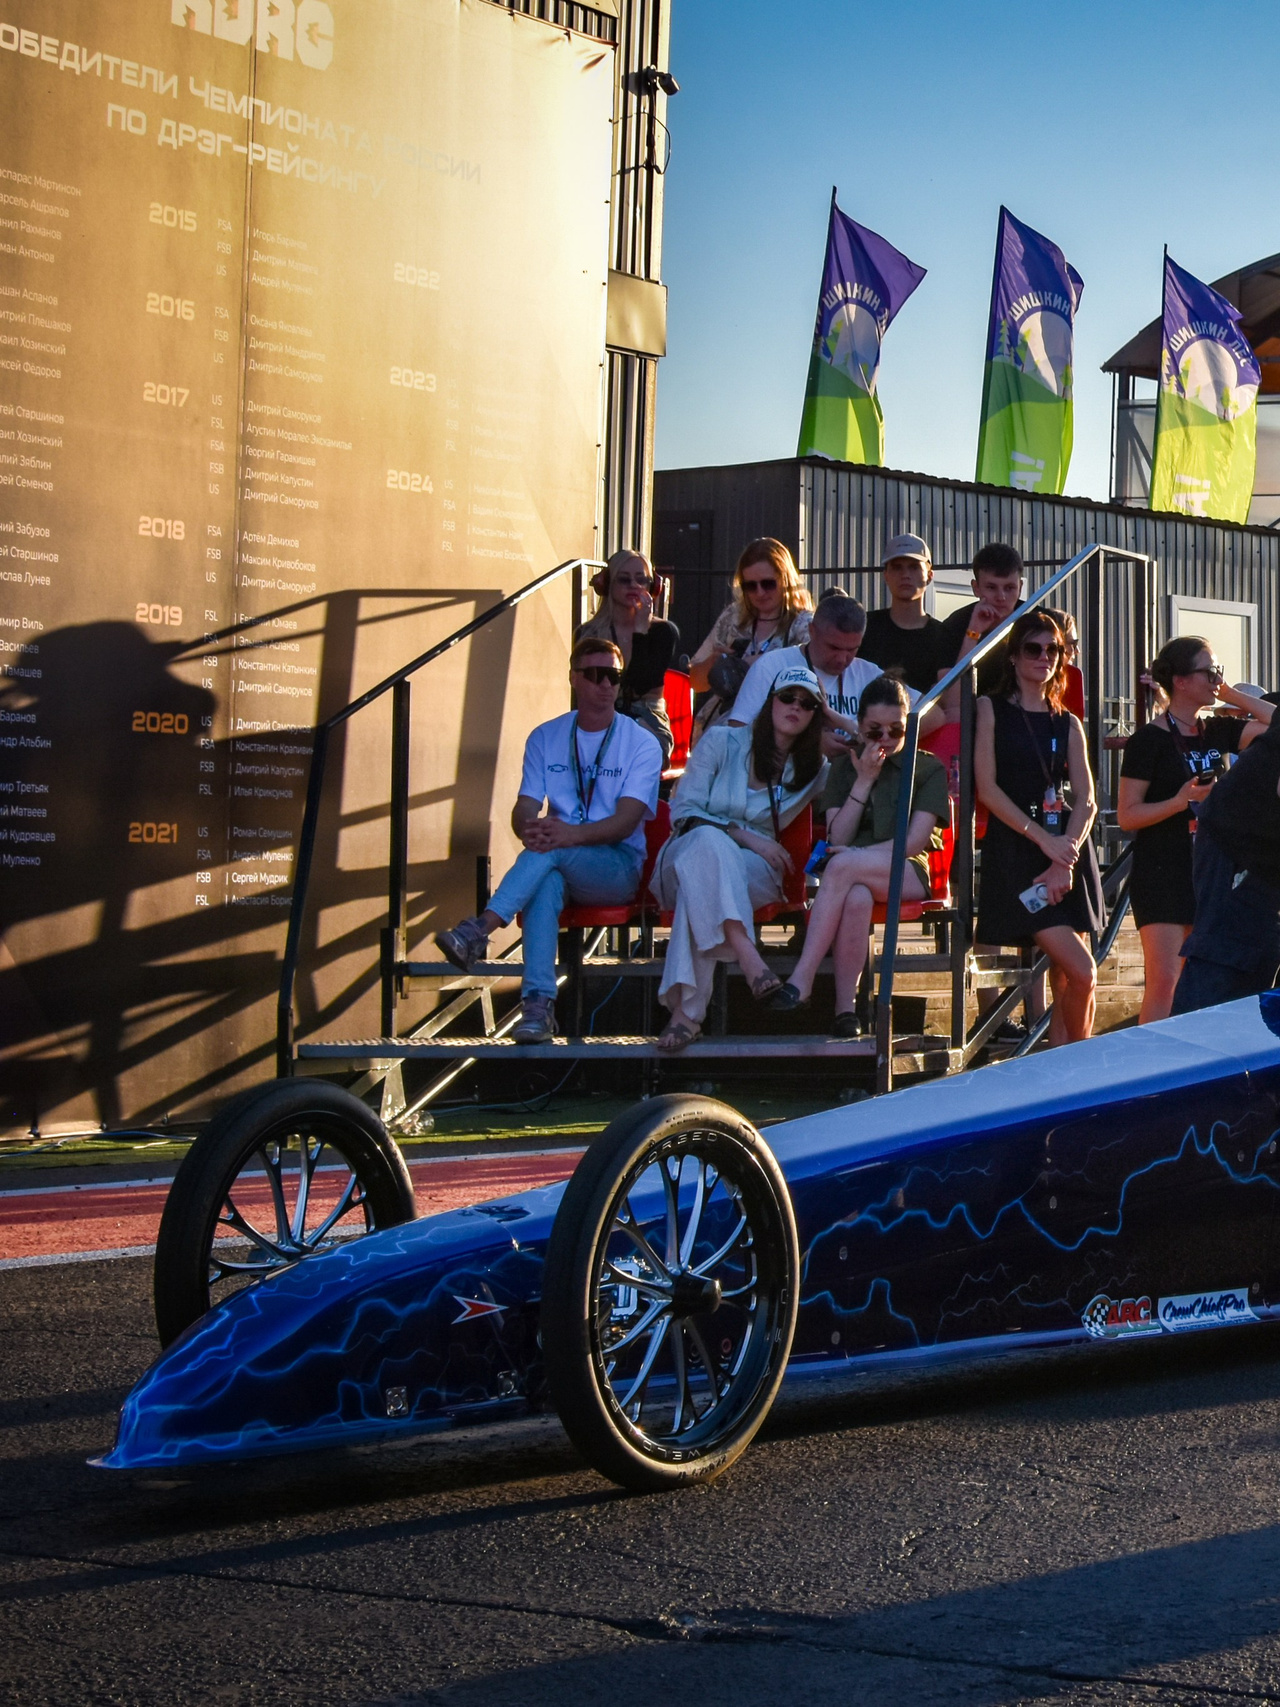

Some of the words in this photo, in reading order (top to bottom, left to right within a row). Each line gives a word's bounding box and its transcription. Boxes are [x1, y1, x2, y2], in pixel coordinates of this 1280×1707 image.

[0, 23, 178, 99] ОБЕДИТЕЛИ
[188, 76, 373, 155] ЧЕМПИОНАТА
[107, 102, 147, 136] ПО
[157, 117, 388, 199] ДРЭГ-РЕЙСИНГУ
[149, 202, 197, 232] 2015
[217, 218, 233, 232] FSA
[216, 241, 232, 254] FSB
[216, 265, 227, 276] US
[394, 262, 440, 290] 2022
[145, 292, 195, 321] 2016
[214, 306, 230, 319] FSA
[1010, 291, 1071, 322] ШИШКИН
[213, 329, 229, 342] FSB
[1169, 320, 1228, 353] ШИШКИН
[213, 352, 224, 363] US
[390, 366, 437, 393] 2023
[143, 382, 190, 407] 2017
[211, 394, 223, 406] US
[211, 417, 225, 430] FSL
[210, 439, 225, 452] FSA
[209, 462, 225, 475] FSB
[386, 469, 434, 495] 2024
[208, 484, 220, 495] US
[138, 516, 186, 541] 2018
[207, 525, 222, 537] FSA
[206, 548, 222, 560] FSB
[206, 572, 217, 583] US
[241, 575, 276, 590] Дмитрий
[135, 602, 183, 627] 2019
[204, 609, 218, 622] FSL
[203, 655, 218, 667] FSB
[202, 678, 213, 689] US
[237, 680, 272, 696] Дмитрий
[131, 711, 189, 735] 2020
[201, 716, 212, 727] US
[236, 718, 271, 733] Дмитрий
[200, 738, 215, 750] FSA
[200, 761, 215, 773] FSB
[234, 762, 270, 777] Дмитрий
[198, 783, 213, 796] FSL
[128, 822, 178, 844] 2021
[197, 826, 209, 838] US
[196, 849, 212, 860] FSA
[196, 871, 211, 883] FSB
[231, 871, 259, 885] Сергей
[259, 871, 289, 886] Мудрик
[195, 894, 210, 906] FSL
